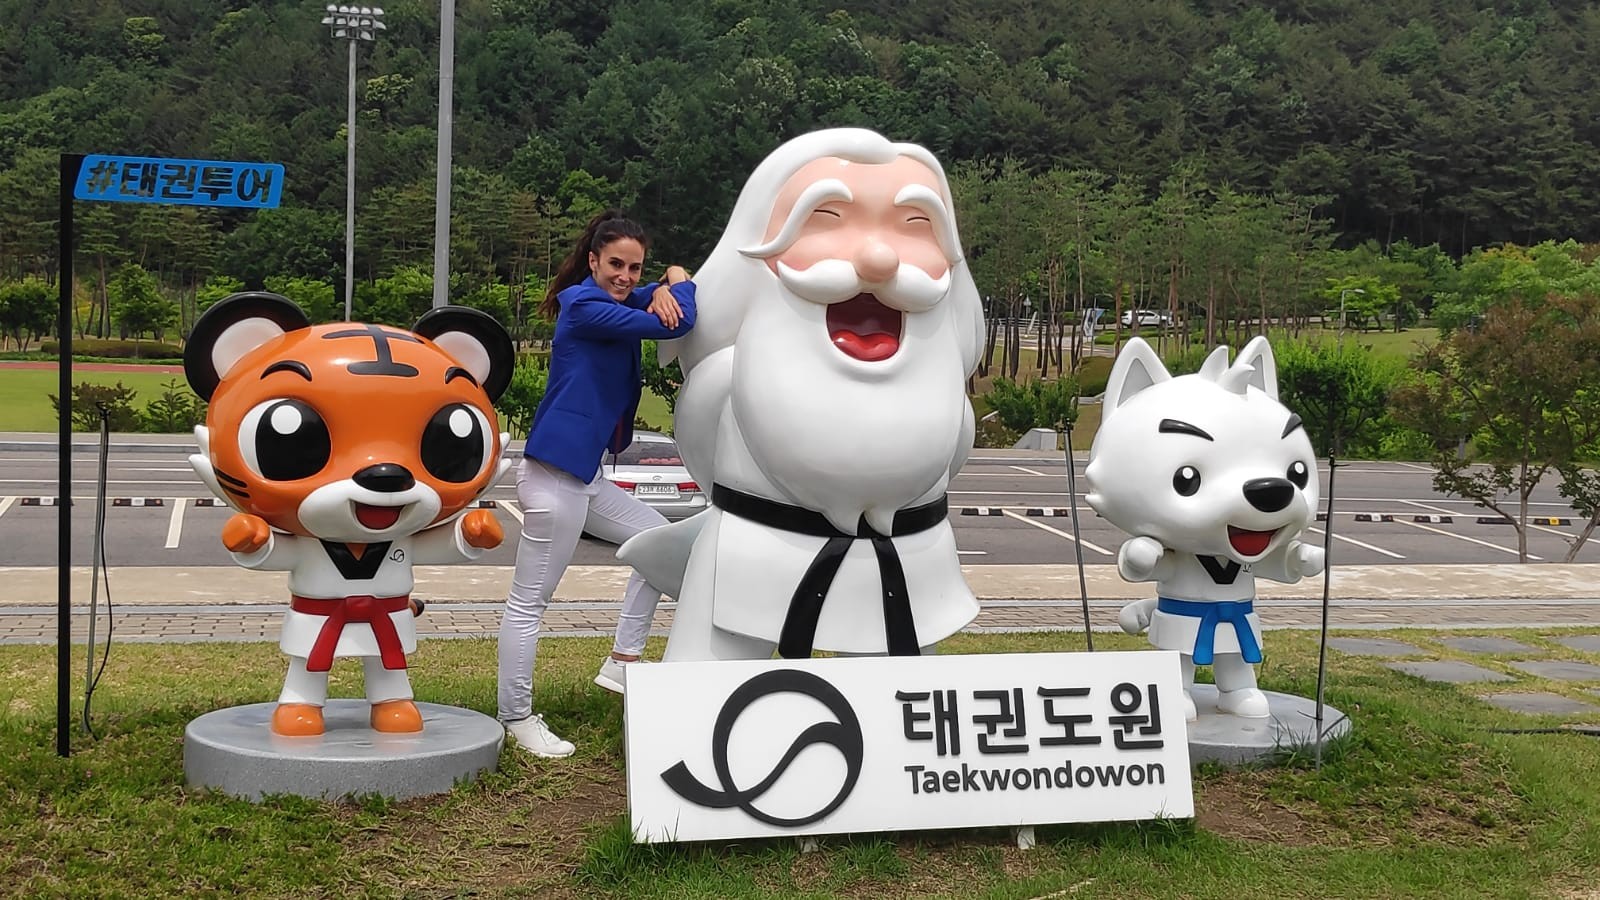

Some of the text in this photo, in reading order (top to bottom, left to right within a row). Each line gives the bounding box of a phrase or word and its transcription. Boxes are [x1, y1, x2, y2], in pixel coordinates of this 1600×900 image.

[86, 160, 273, 203] #태권투어
[895, 682, 1165, 756] 태권도원
[904, 760, 1165, 794] Taekwondowon
